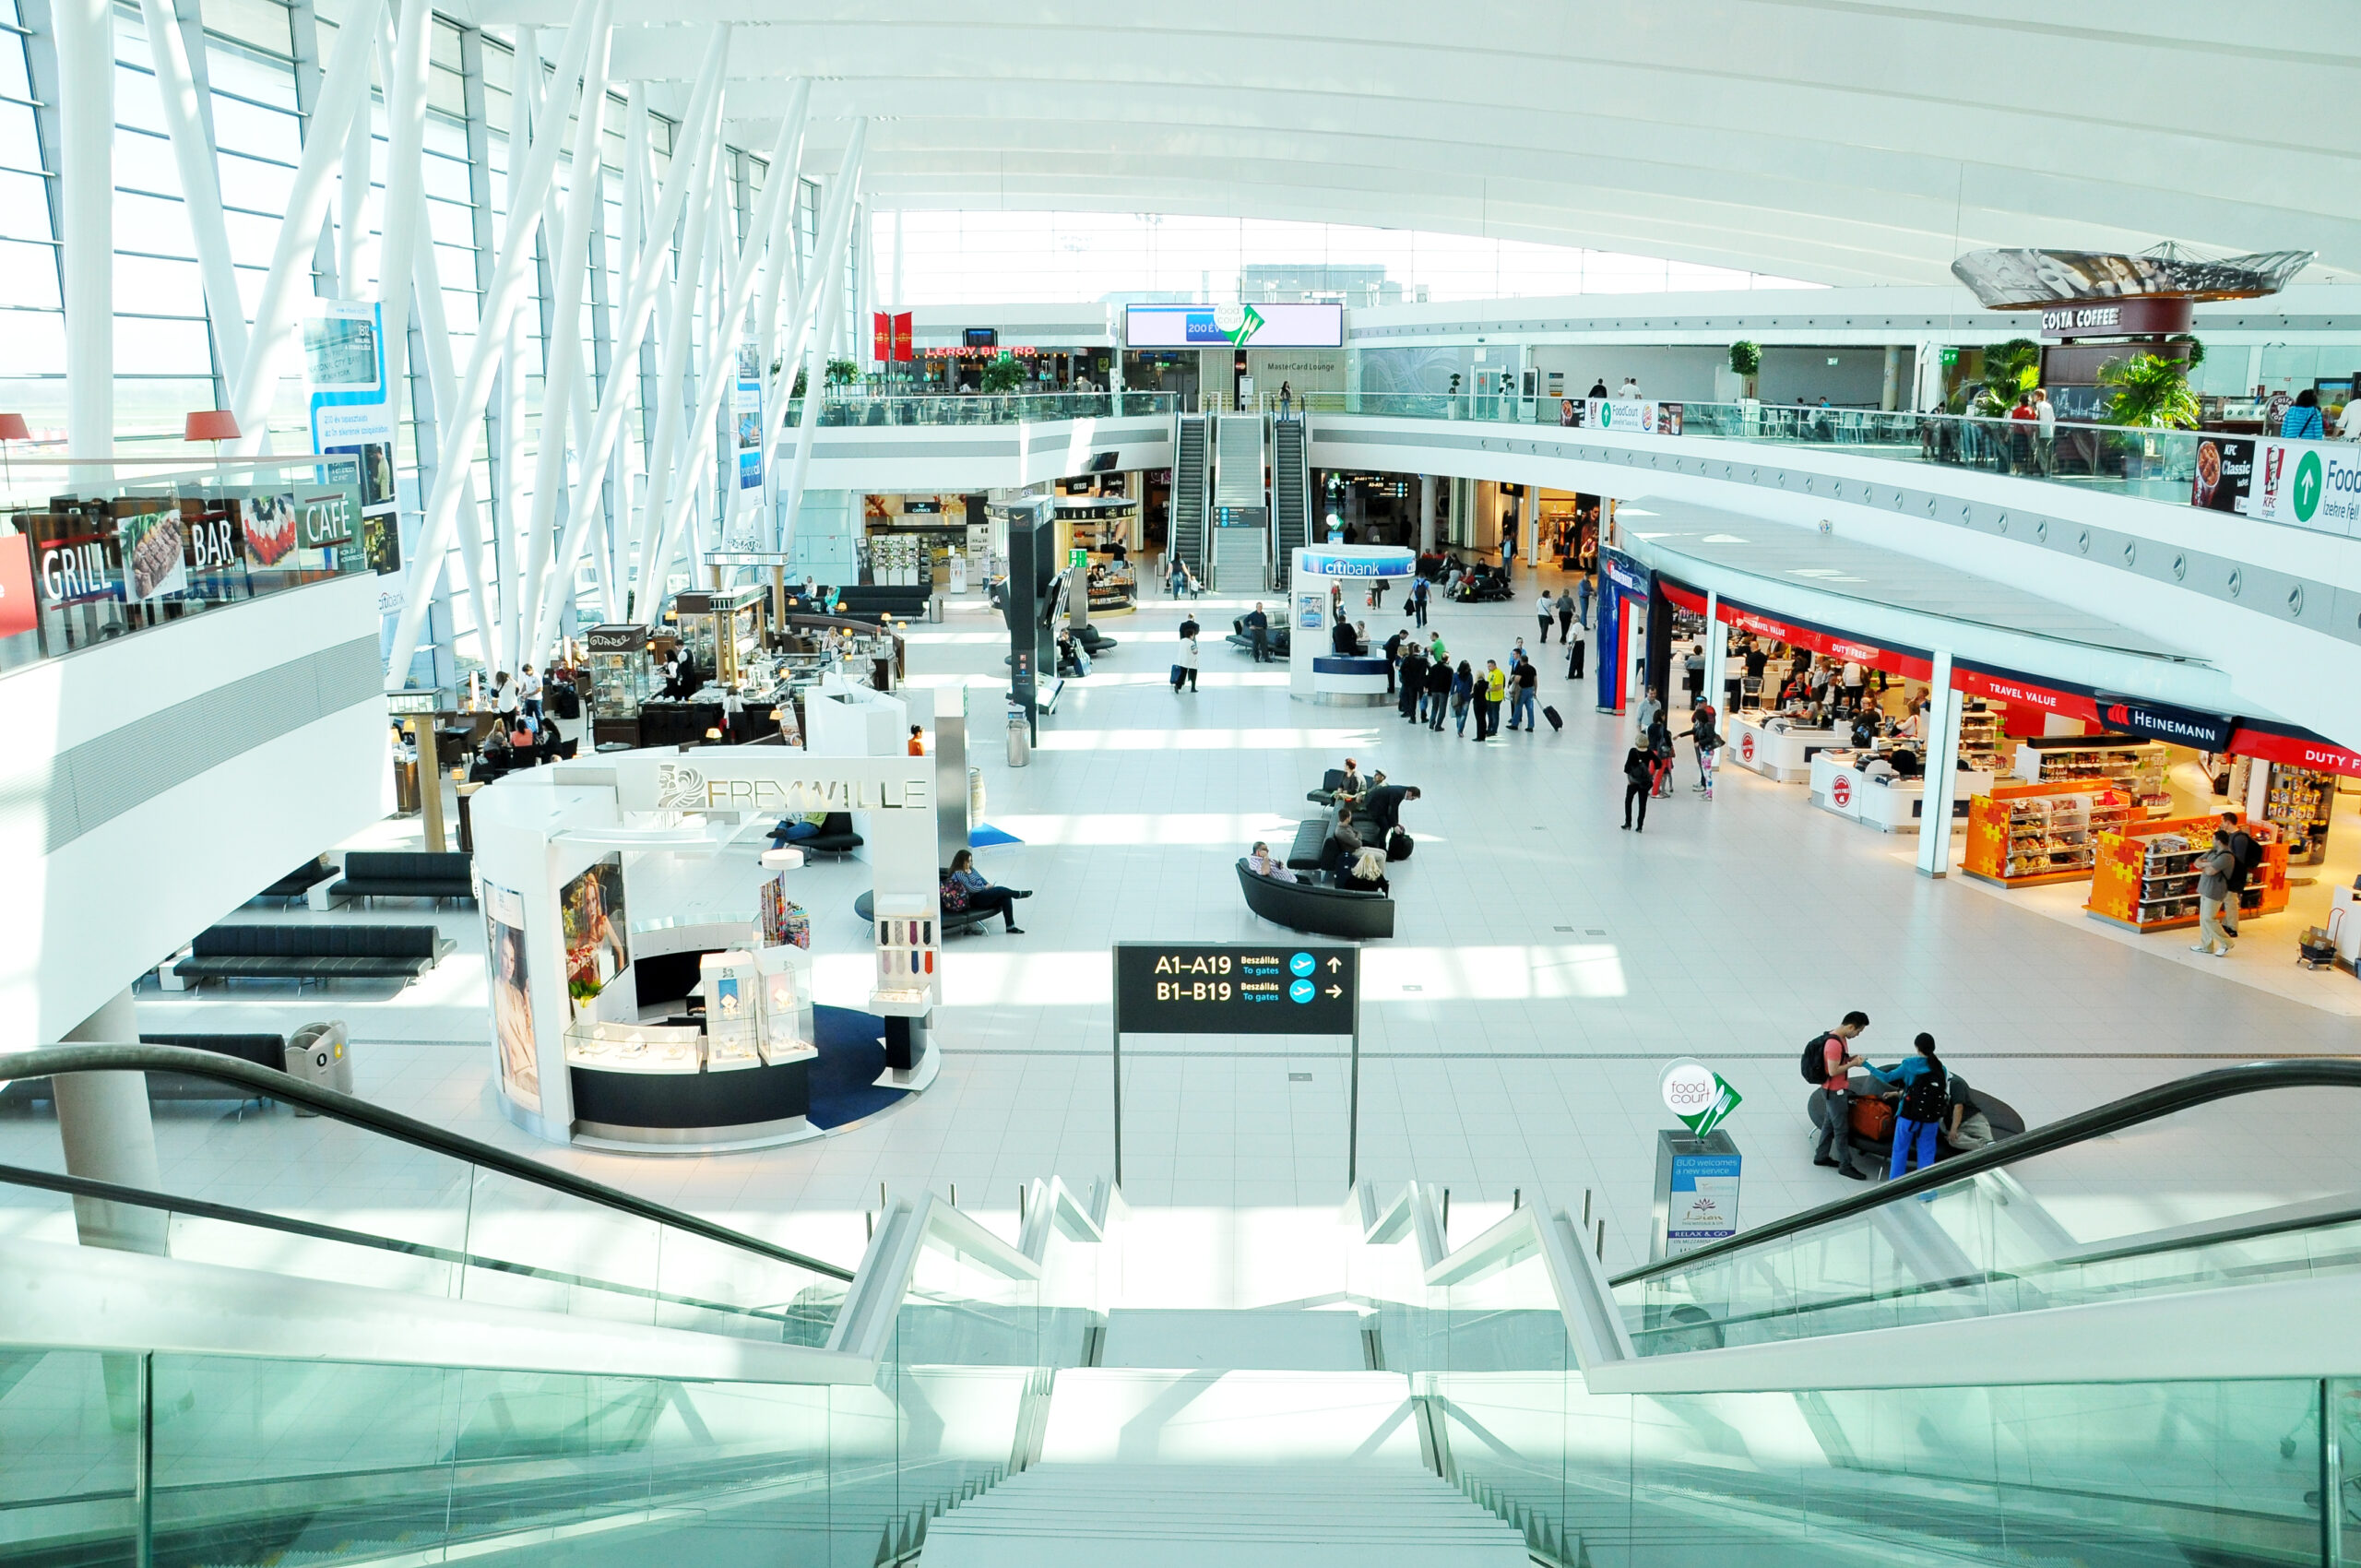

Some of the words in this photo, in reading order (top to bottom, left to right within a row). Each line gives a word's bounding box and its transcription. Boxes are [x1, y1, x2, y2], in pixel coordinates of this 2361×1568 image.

[2042, 311, 2072, 330] COSTA
[2076, 308, 2119, 327] COFFEE
[1188, 324, 1207, 333] 200
[926, 347, 976, 356] LEROY
[1267, 362, 1308, 371] MasterCard
[1309, 363, 1335, 373] Lounge
[1612, 405, 1639, 418] FoodCourt
[2224, 445, 2238, 456] KFC
[2222, 460, 2251, 475] Classic
[2262, 496, 2277, 508] KFC
[305, 493, 352, 542] CAFÉ
[192, 520, 234, 567] BAR
[42, 542, 113, 600] GRILL
[1325, 559, 1380, 576] citibank
[1752, 621, 1768, 632] TRAVEL
[1770, 625, 1786, 637] VALUE
[1832, 643, 1849, 655] DUTY
[1850, 649, 1867, 659] FREE
[1989, 683, 2023, 698] TRAVEL
[2025, 691, 2057, 707] VALUE
[2134, 710, 2215, 741] HEINEMANN
[2305, 750, 2347, 766] DUTY
[707, 780, 927, 809] FREYWILLE
[1240, 956, 1279, 965] Beszállás
[1255, 966, 1279, 976] gates
[1240, 982, 1279, 991] Beszállás
[1255, 992, 1279, 1003] gates
[1671, 1080, 1705, 1094] food
[1670, 1088, 1711, 1104] court
[1676, 1158, 1695, 1167] BUD
[1697, 1158, 1738, 1167] welcomes
